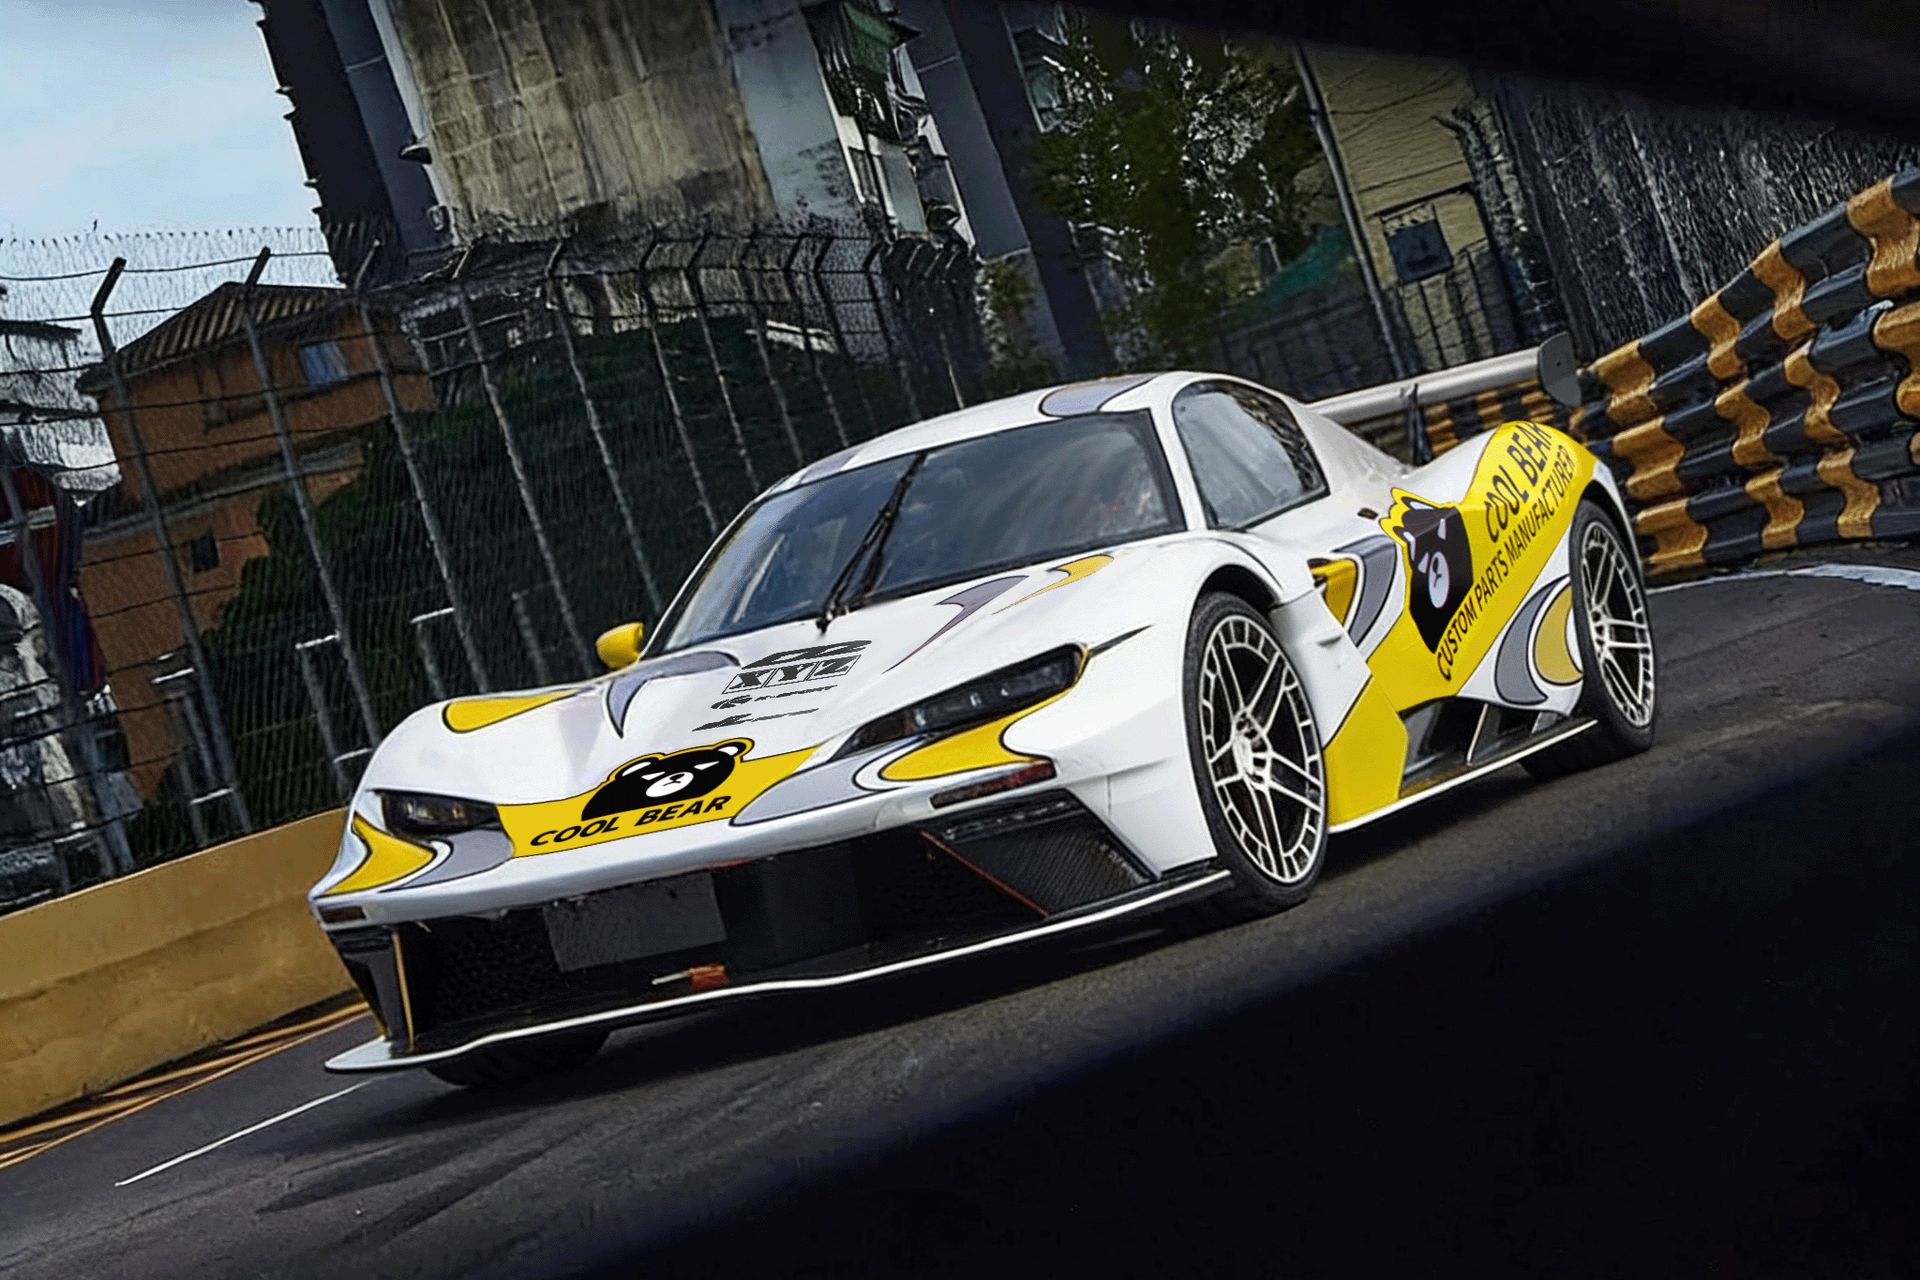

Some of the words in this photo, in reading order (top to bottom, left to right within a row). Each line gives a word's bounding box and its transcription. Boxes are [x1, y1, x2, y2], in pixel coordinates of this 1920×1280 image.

[1484, 464, 1529, 543] COOL
[1507, 422, 1552, 487] BEAR
[1437, 596, 1478, 682] CUSTOM
[1474, 550, 1509, 612] PARTS
[1504, 444, 1576, 566] MANUFACTURER
[728, 655, 858, 690] XYZ
[530, 816, 620, 846] COOL
[633, 795, 732, 827] BEAR
